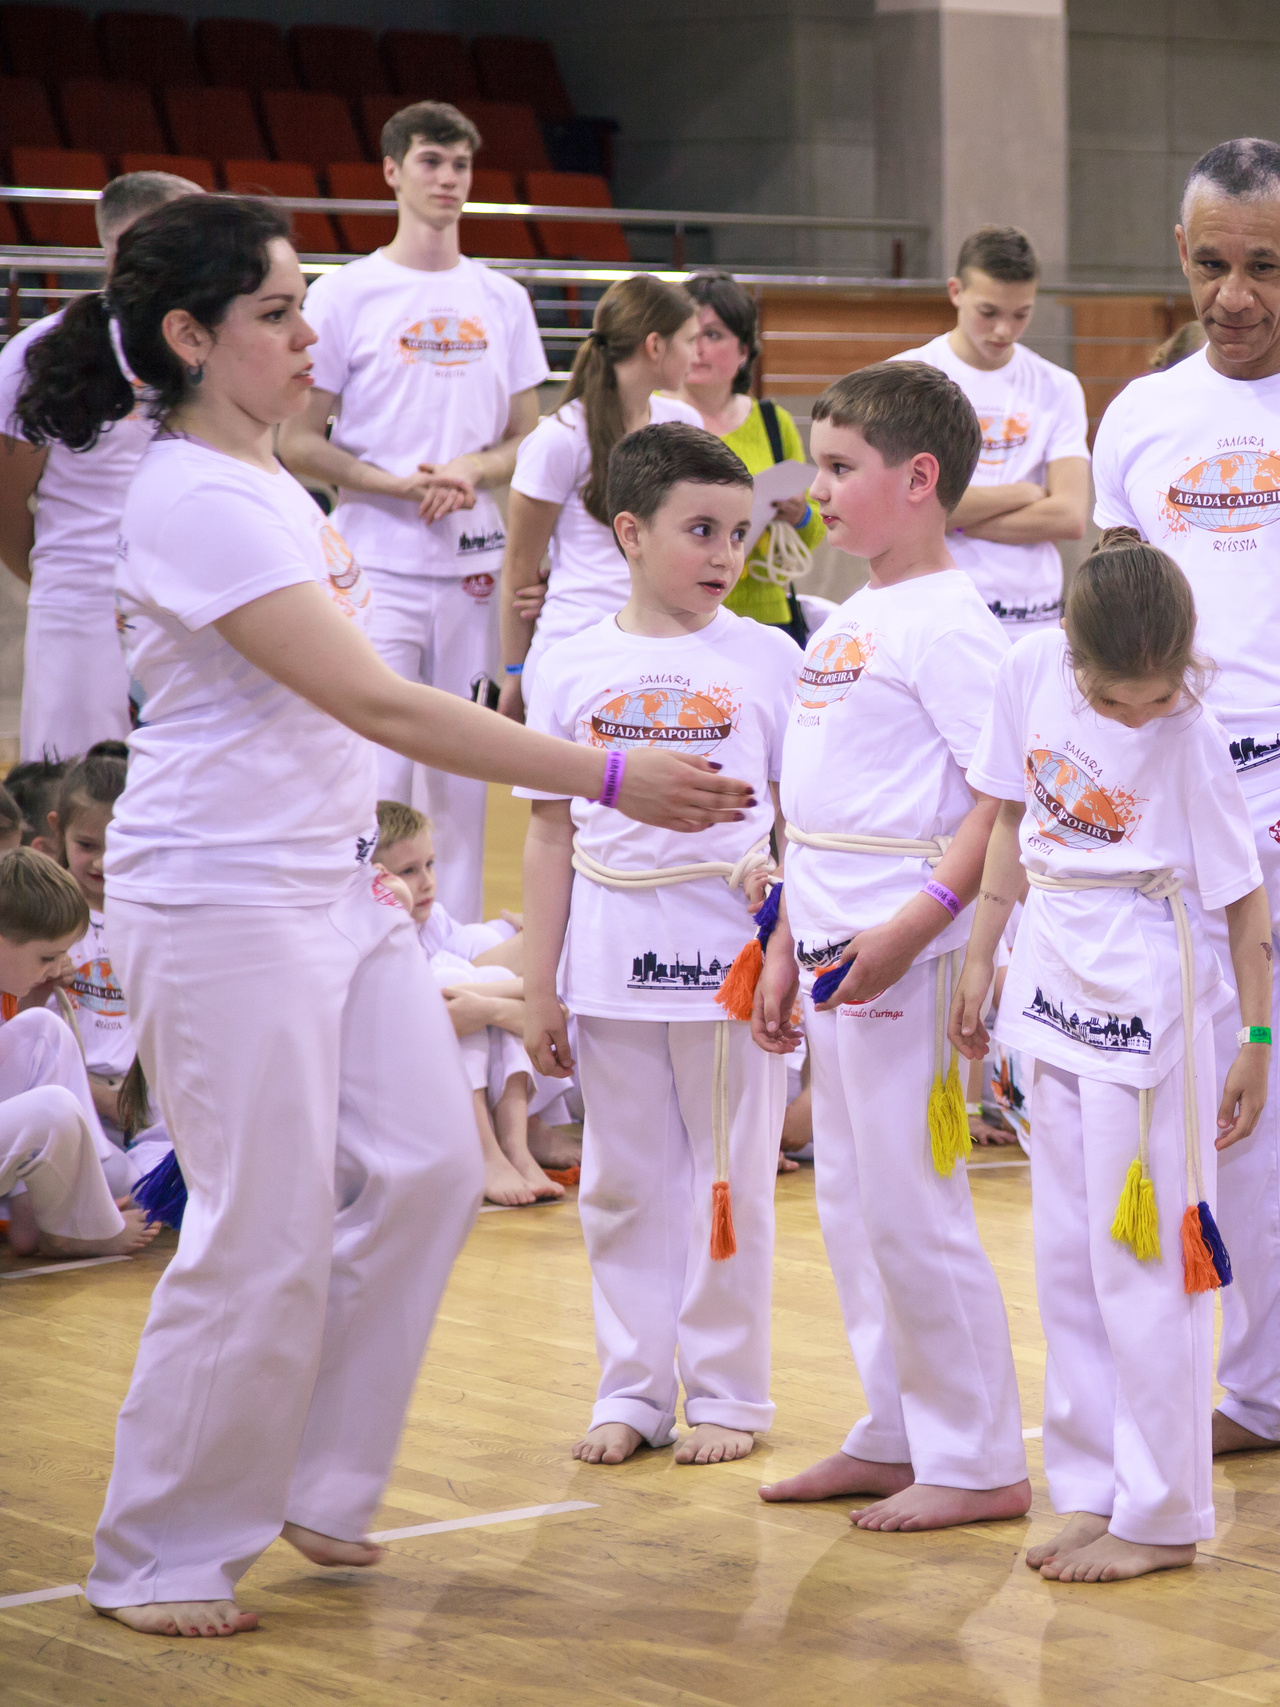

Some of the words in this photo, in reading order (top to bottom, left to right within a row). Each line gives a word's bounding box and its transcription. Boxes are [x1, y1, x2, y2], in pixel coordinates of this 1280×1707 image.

[1216, 435, 1265, 450] SAMARA
[638, 673, 691, 688] SAMARA
[597, 723, 723, 740] ABADÁ-CAPOEIRA
[1062, 740, 1104, 779] SAMARA
[869, 1008, 905, 1021] Curinga
